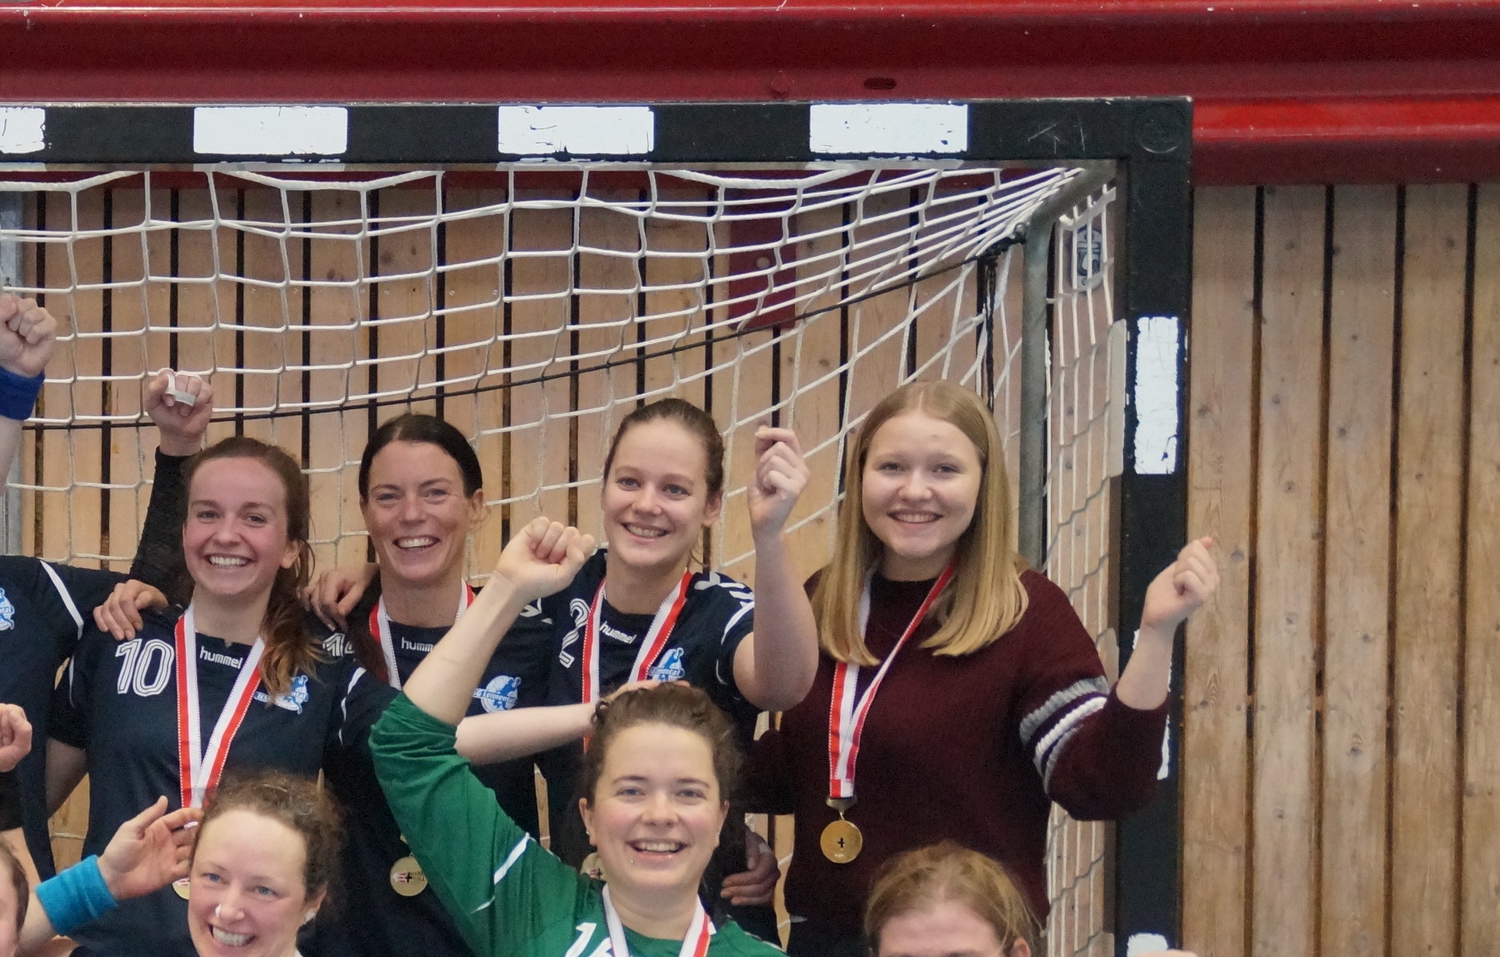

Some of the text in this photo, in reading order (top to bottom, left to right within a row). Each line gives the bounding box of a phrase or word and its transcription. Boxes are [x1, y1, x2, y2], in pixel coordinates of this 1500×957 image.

[401, 637, 434, 652] humm
[115, 638, 175, 697] 10
[200, 646, 244, 670] hummel
